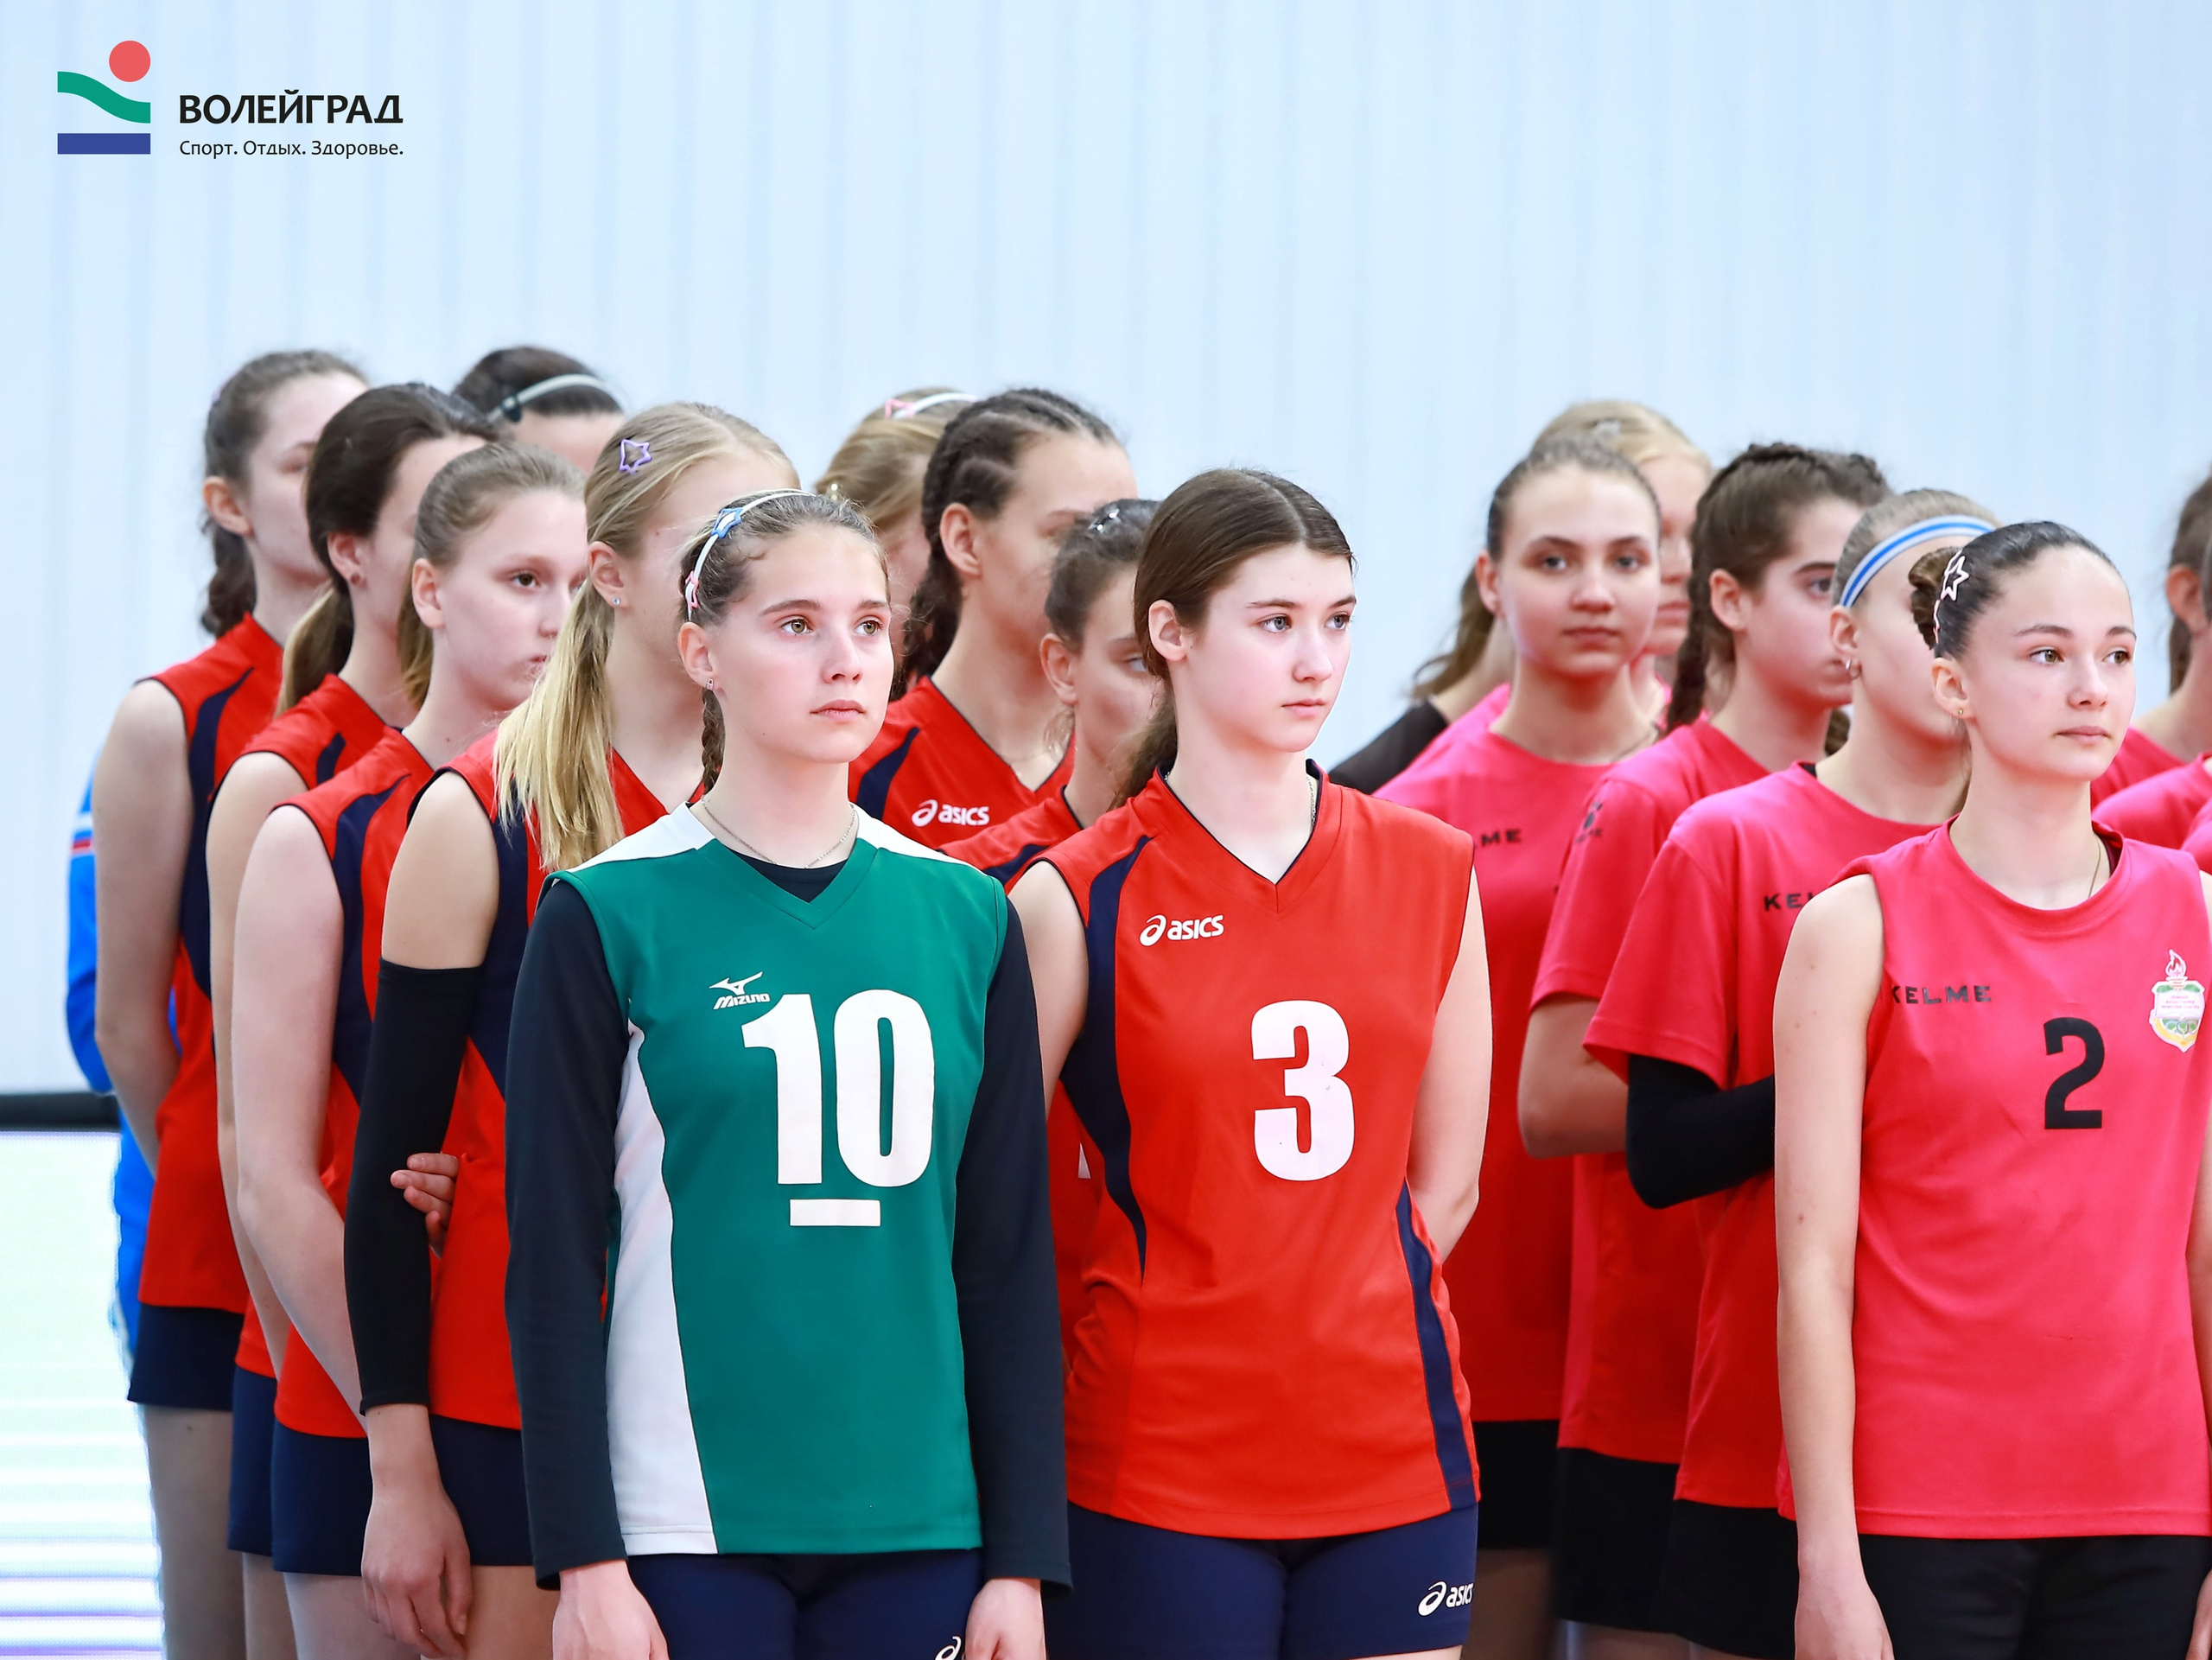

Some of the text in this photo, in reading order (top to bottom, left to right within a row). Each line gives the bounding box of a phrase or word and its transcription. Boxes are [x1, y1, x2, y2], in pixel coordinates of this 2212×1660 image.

[1166, 914, 1224, 941] asics
[741, 989, 935, 1187] 10
[1250, 999, 1356, 1182] 3
[2043, 1016, 2105, 1129] 2
